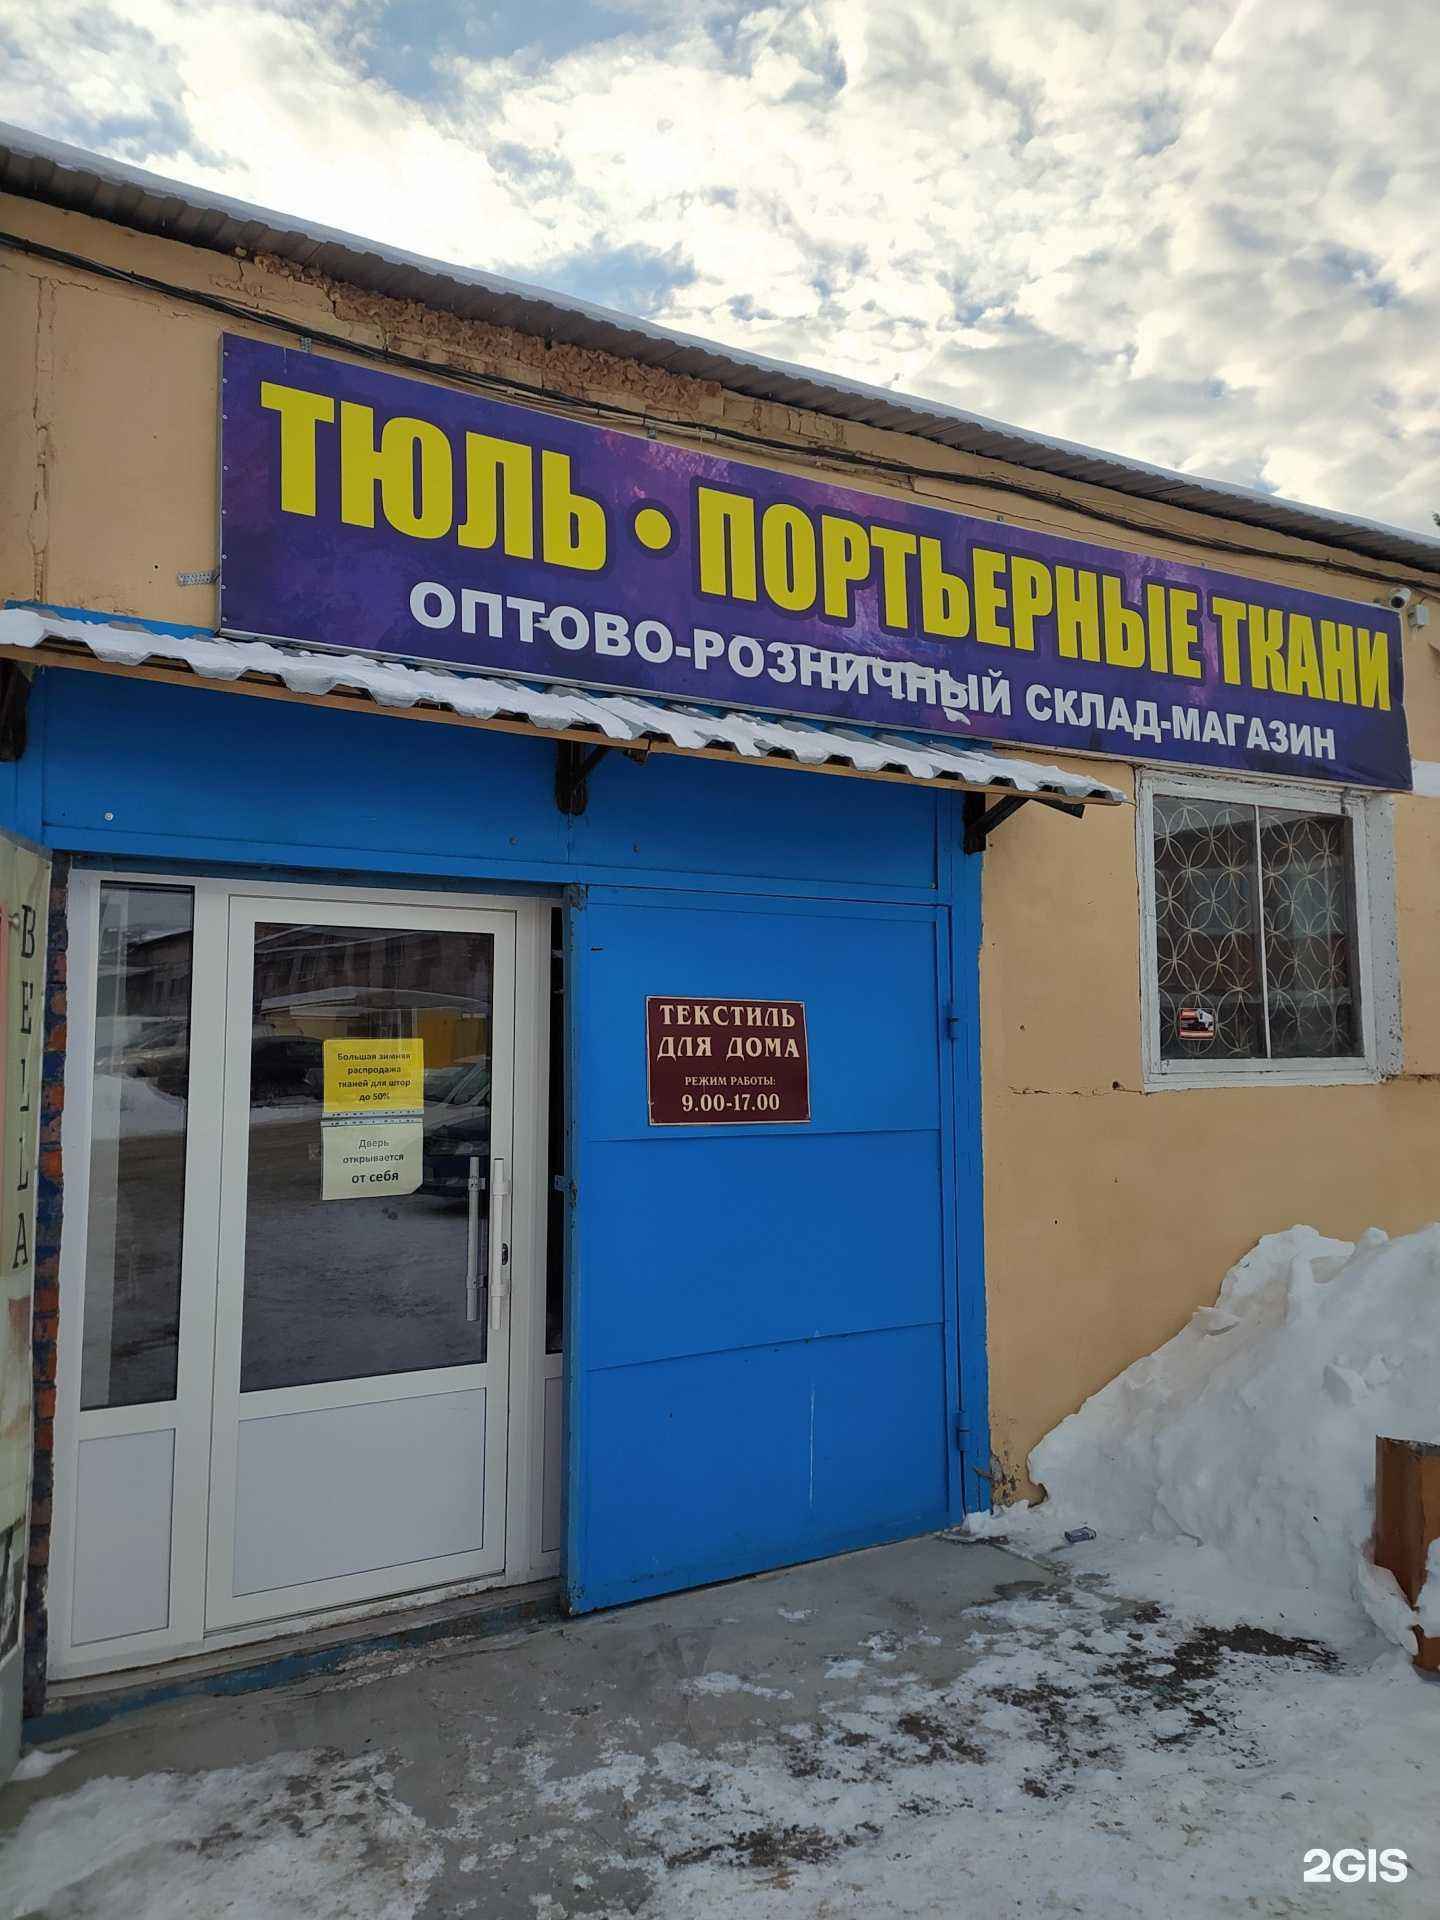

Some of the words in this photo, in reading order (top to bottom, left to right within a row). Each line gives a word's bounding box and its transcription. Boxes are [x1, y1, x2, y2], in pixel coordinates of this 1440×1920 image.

[260, 381, 607, 571] ТЮЛЬ
[698, 486, 1202, 679] ПОРТЬЕРНЫЕ
[1212, 597, 1391, 711] ТКАНИ
[409, 581, 1011, 716] ОПТОВО-РОЗНИЧНЫЙ
[1026, 684, 1336, 760] СКЛАД-МАГАЗИН
[660, 1005, 796, 1027] ТЕКСТИЛЬ
[656, 1036, 713, 1062] ДЛЯ
[725, 1037, 800, 1062] ДОМА
[347, 1067, 401, 1075] распродажа
[338, 1080, 368, 1088] тканей
[685, 1077, 727, 1086] РЕЖИМ
[731, 1077, 776, 1086] РАБОТЫ:
[681, 1093, 780, 1111] 9.00-17.00
[359, 1139, 389, 1149] Дверь
[343, 1154, 404, 1164] открывается
[352, 1176, 366, 1184] от
[369, 1171, 399, 1182] себя
